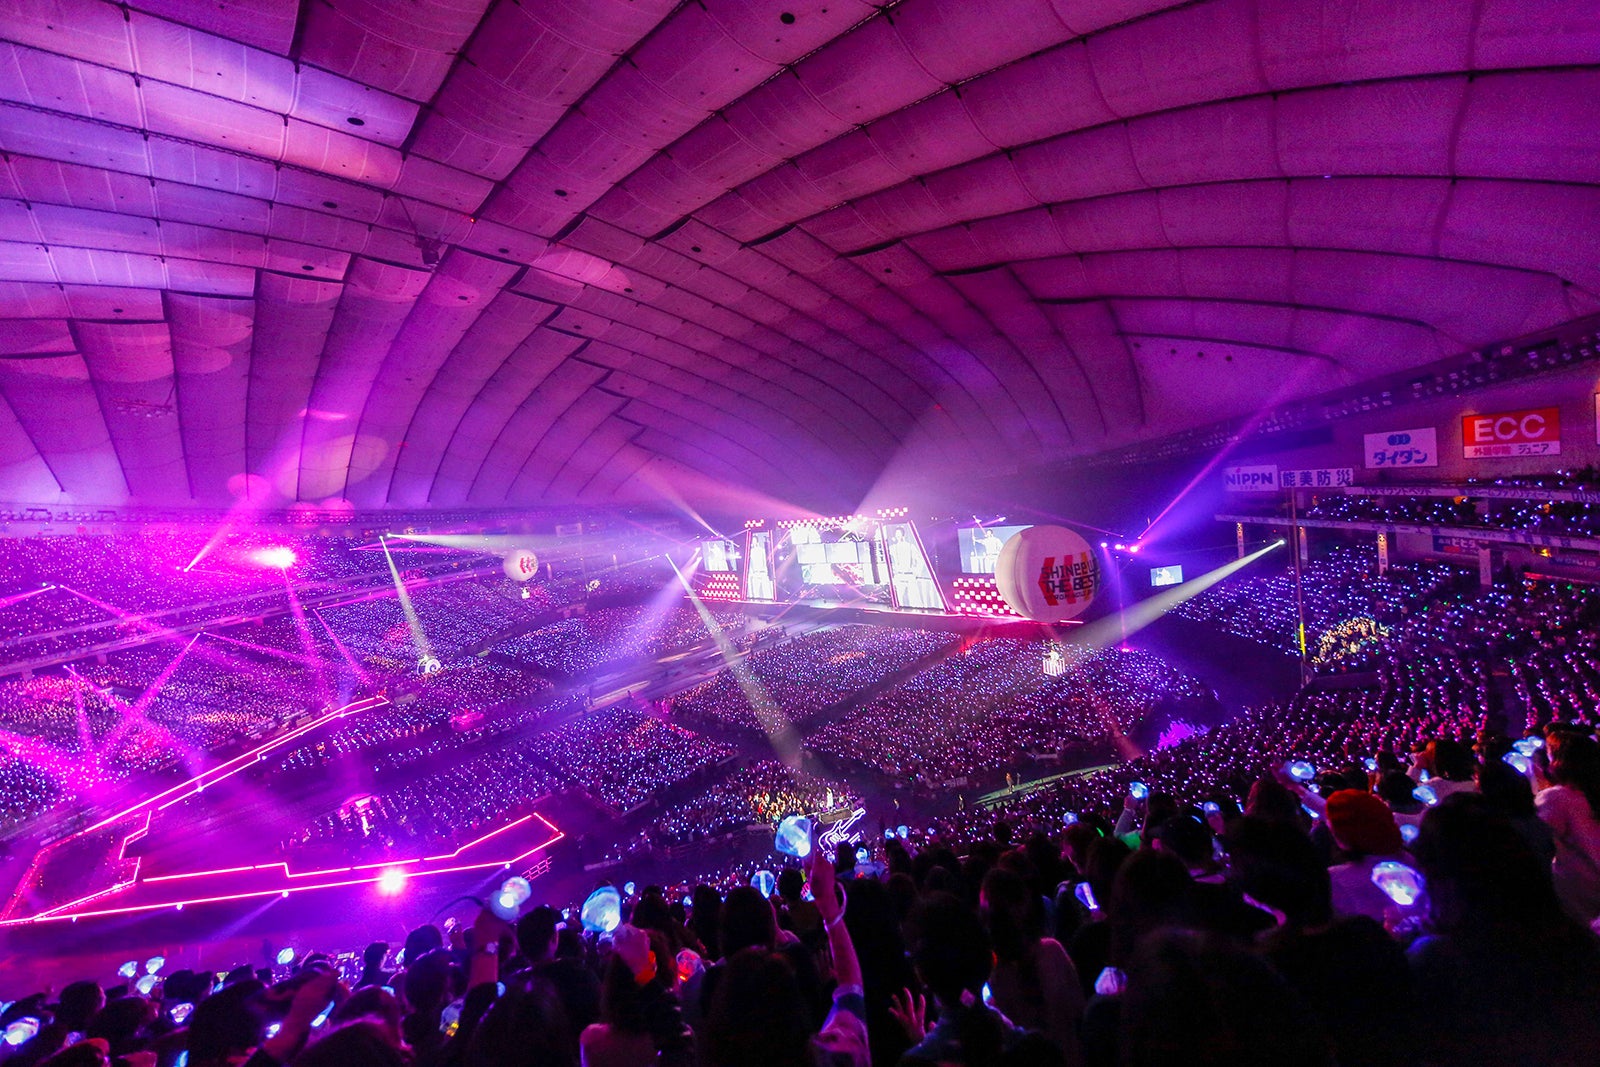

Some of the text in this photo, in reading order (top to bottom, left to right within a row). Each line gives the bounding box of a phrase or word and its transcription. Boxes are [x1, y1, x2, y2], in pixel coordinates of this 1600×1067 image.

[1474, 414, 1546, 442] ECC
[1373, 448, 1427, 466] ダイダン
[1518, 444, 1549, 454] ジュニア
[1282, 469, 1351, 486] 能美防災
[1045, 578, 1070, 593] THE
